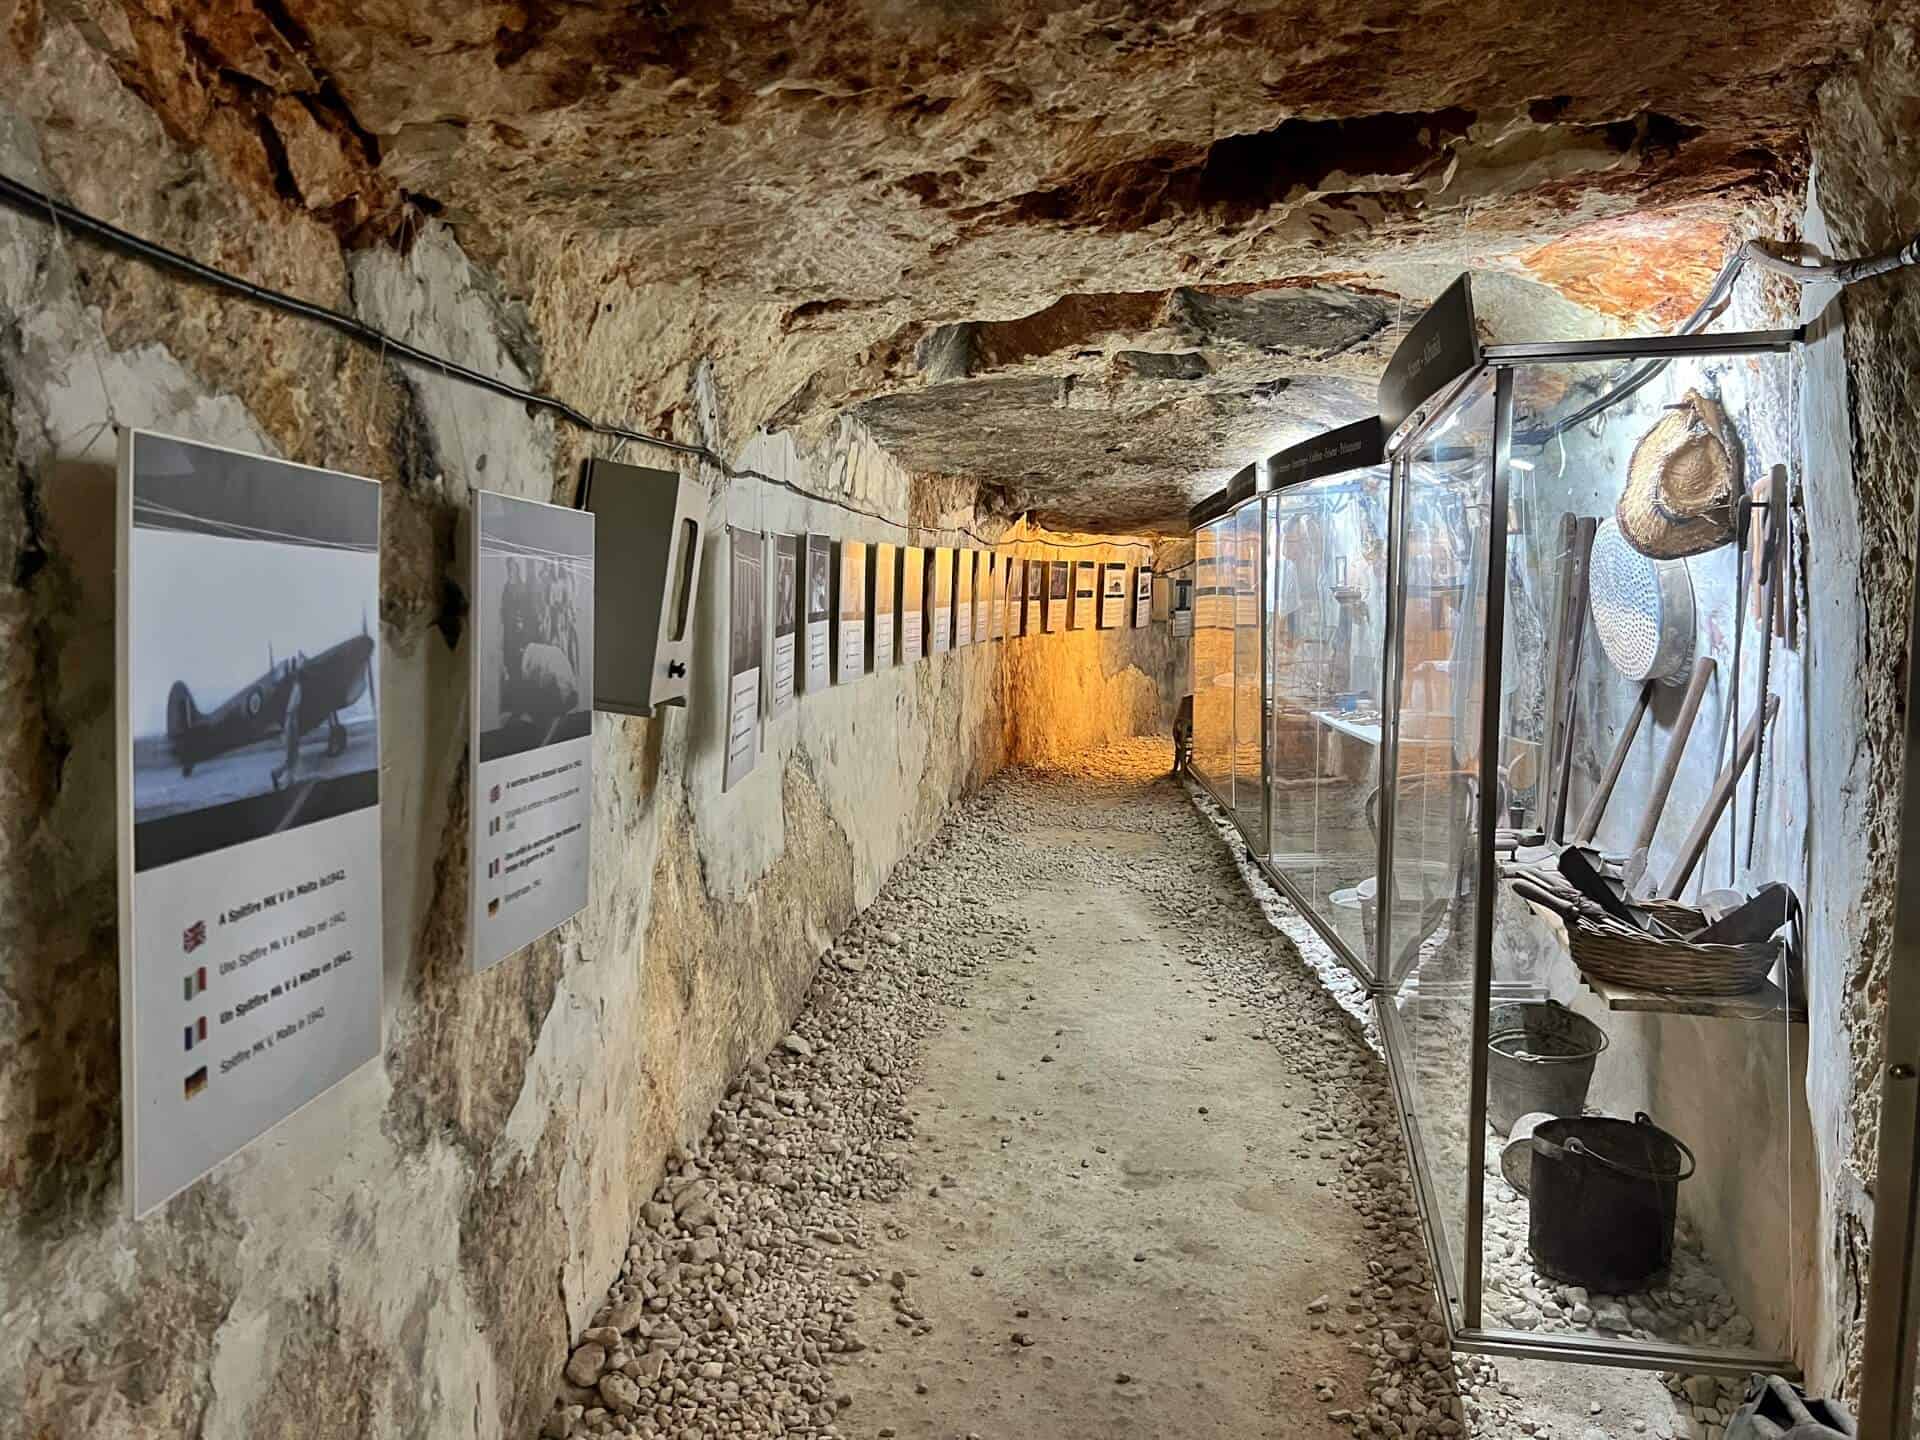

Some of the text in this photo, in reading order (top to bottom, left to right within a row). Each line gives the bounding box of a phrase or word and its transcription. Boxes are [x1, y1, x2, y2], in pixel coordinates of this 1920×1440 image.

[229, 902, 261, 922] Spitfire
[297, 881, 318, 896] Malta
[239, 947, 268, 968] Spitfire
[297, 926, 316, 940] Malta
[235, 994, 269, 1017] Spitfire
[300, 968, 321, 984] Malta
[220, 1050, 251, 1074] Spitfire
[277, 1025, 297, 1040] Malta
